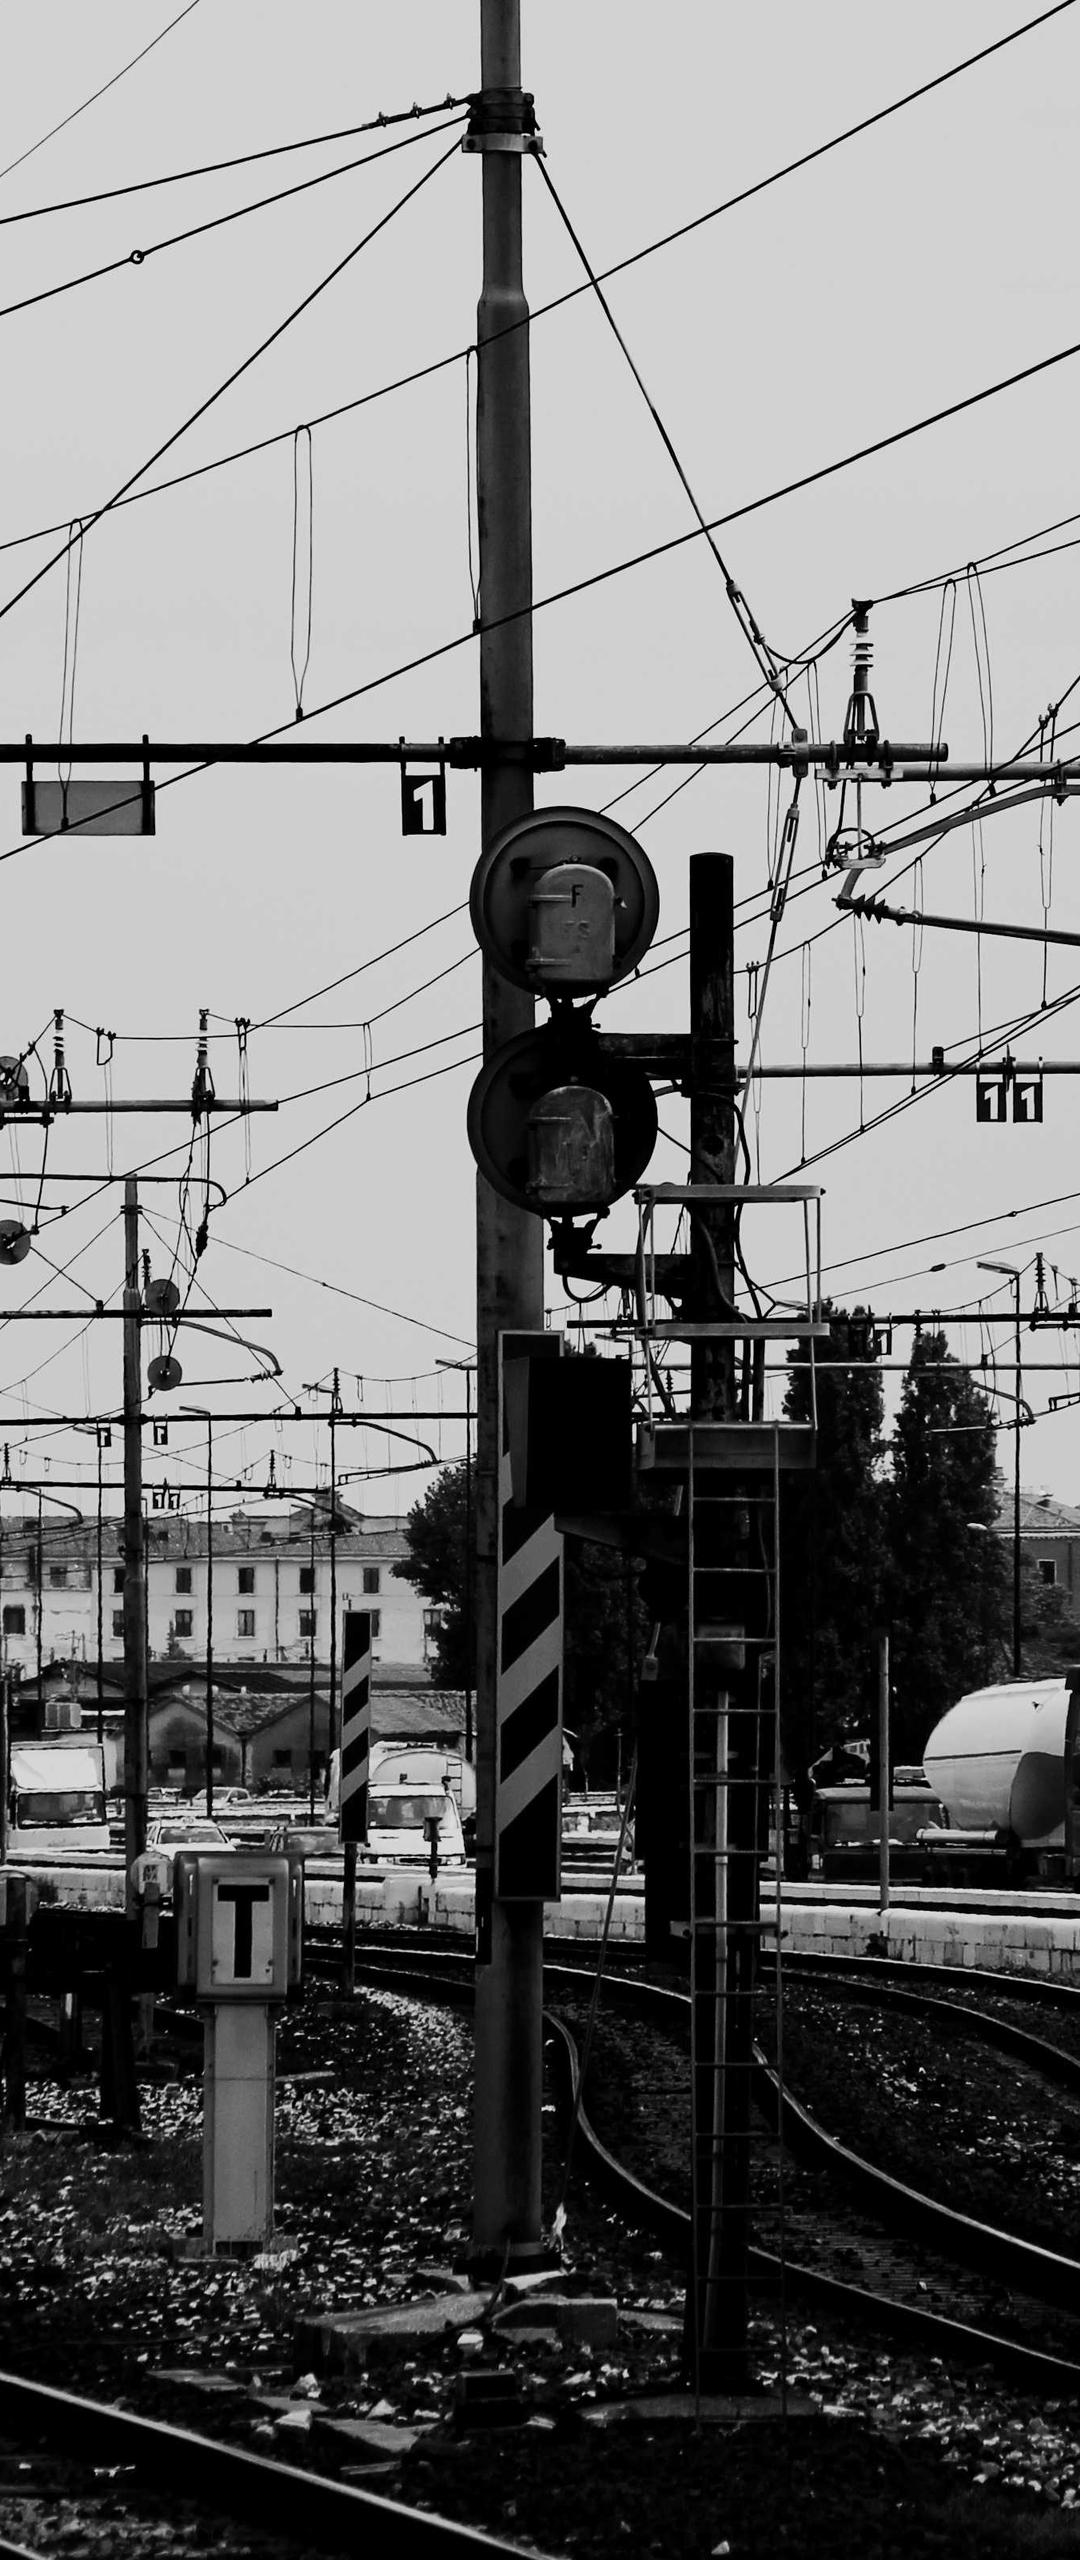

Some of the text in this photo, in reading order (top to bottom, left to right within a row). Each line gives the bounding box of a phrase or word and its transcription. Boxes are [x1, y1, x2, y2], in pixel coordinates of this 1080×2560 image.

[413, 779, 435, 831] 1
[571, 884, 584, 908] F
[218, 1885, 269, 1978] T
